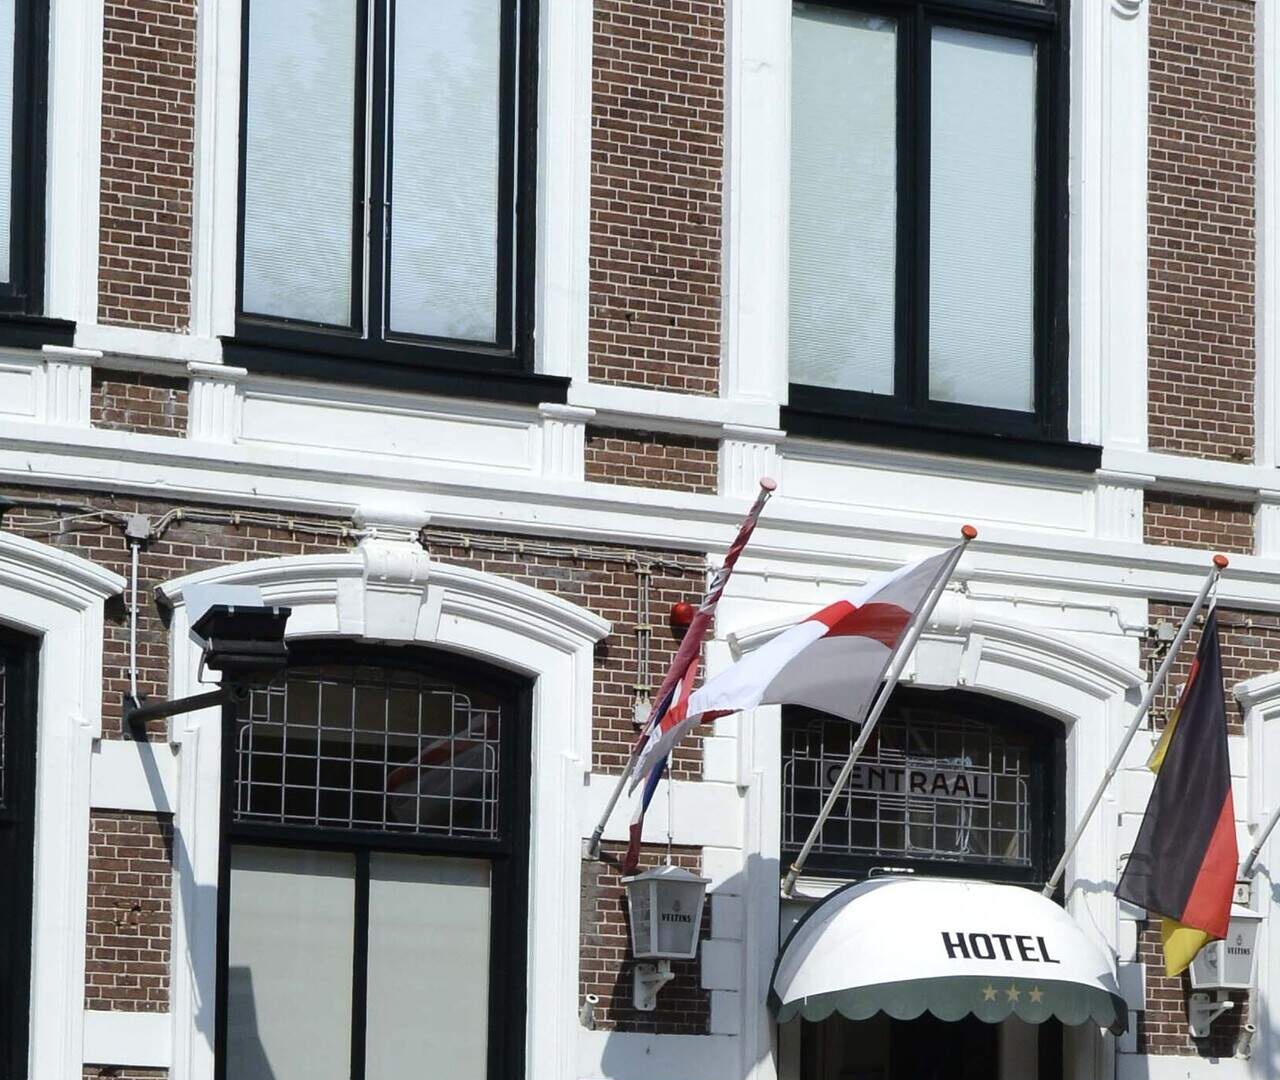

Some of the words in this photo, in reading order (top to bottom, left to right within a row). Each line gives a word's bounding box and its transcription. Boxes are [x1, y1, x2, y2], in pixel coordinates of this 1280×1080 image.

[826, 764, 989, 799] CENTRAAL
[661, 912, 691, 923] VELTINS
[941, 931, 1061, 964] HOTEL
